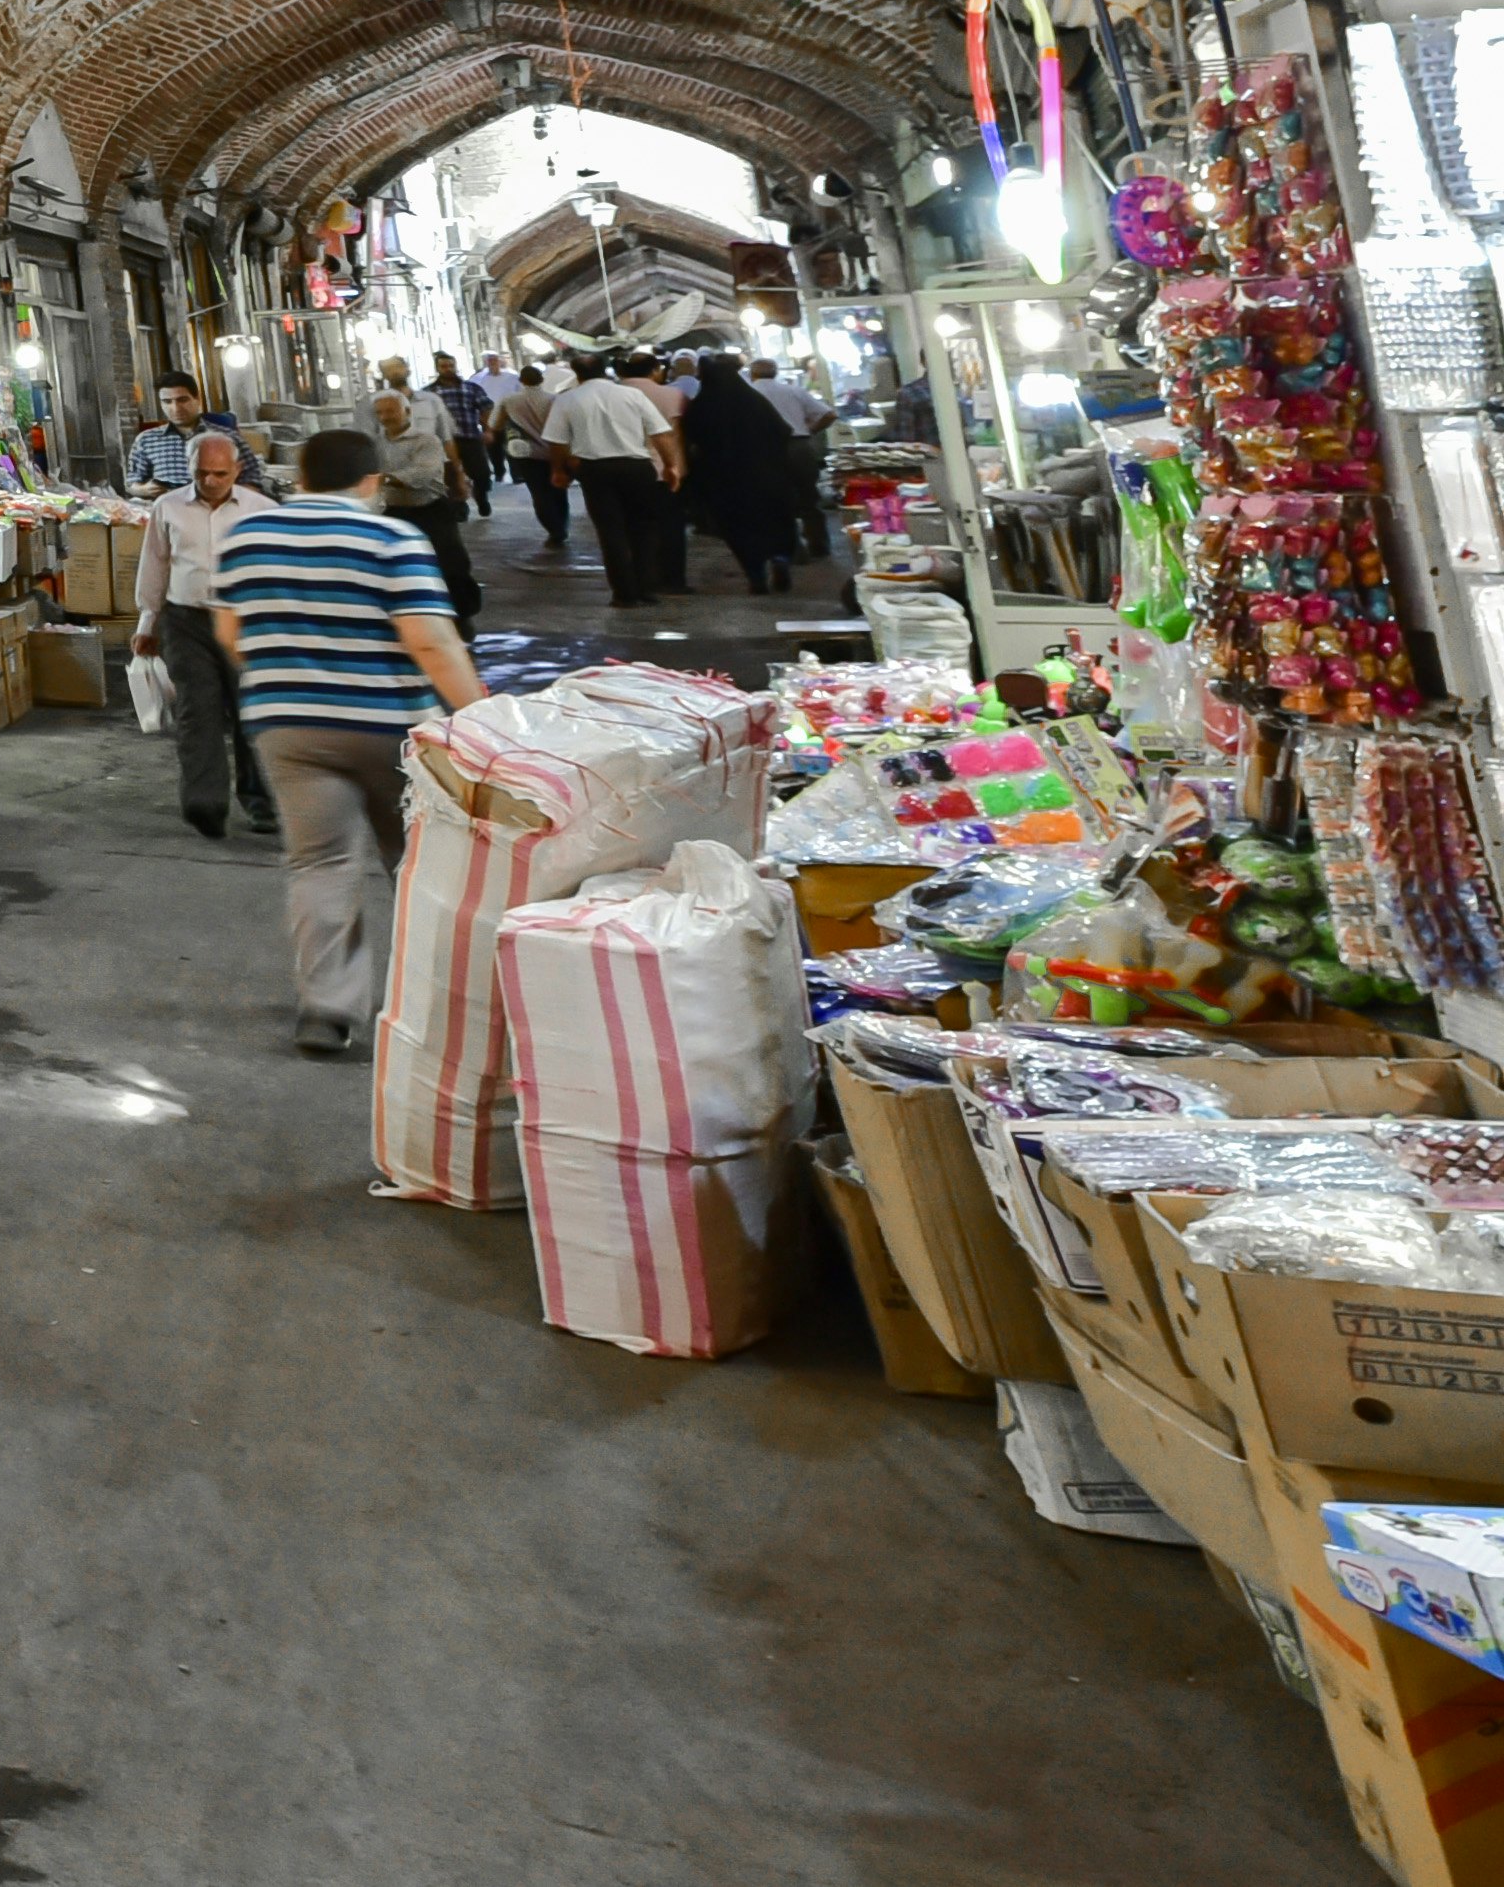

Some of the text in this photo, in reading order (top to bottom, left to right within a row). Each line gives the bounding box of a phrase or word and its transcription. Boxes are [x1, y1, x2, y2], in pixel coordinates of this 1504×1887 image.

[1389, 1321, 1405, 1337] 2
[1432, 1324, 1445, 1340] 3
[1469, 1329, 1485, 1342] 4
[1443, 1372, 1461, 1386] 2
